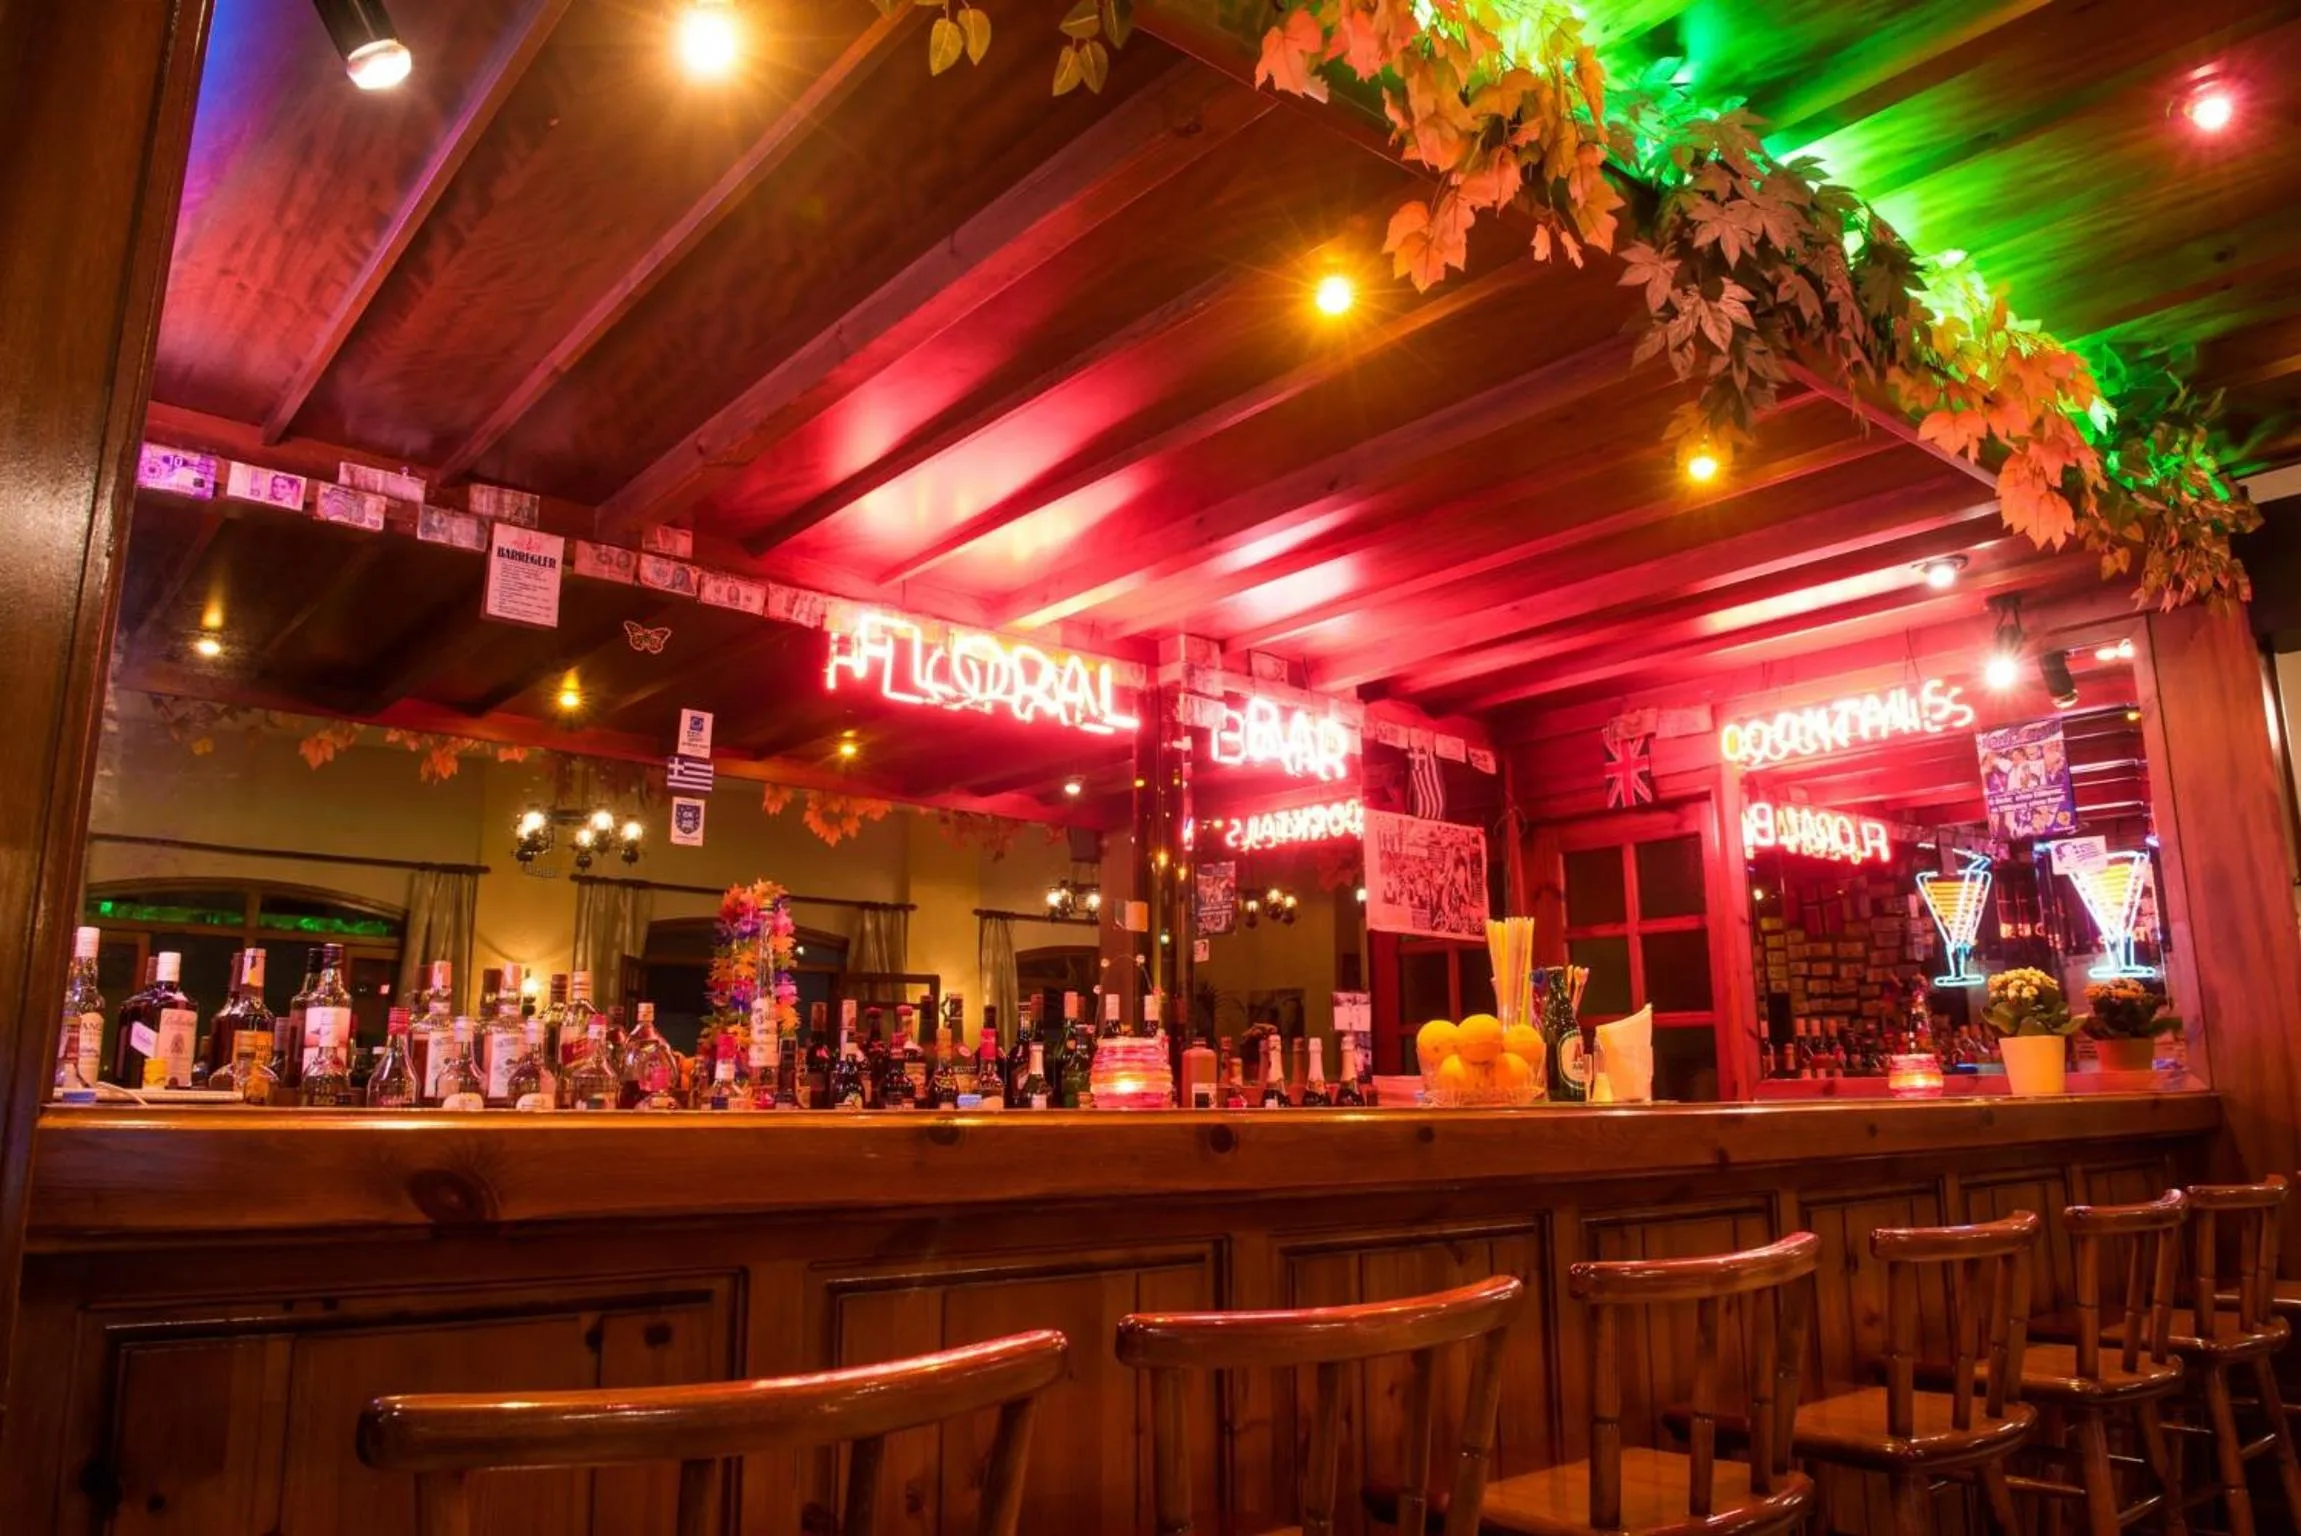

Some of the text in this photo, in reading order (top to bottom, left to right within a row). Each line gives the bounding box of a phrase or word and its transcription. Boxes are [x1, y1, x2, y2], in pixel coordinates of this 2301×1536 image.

[846, 611, 1347, 781] FLORAL BAR
[1721, 680, 1974, 765] COCKTAILS
